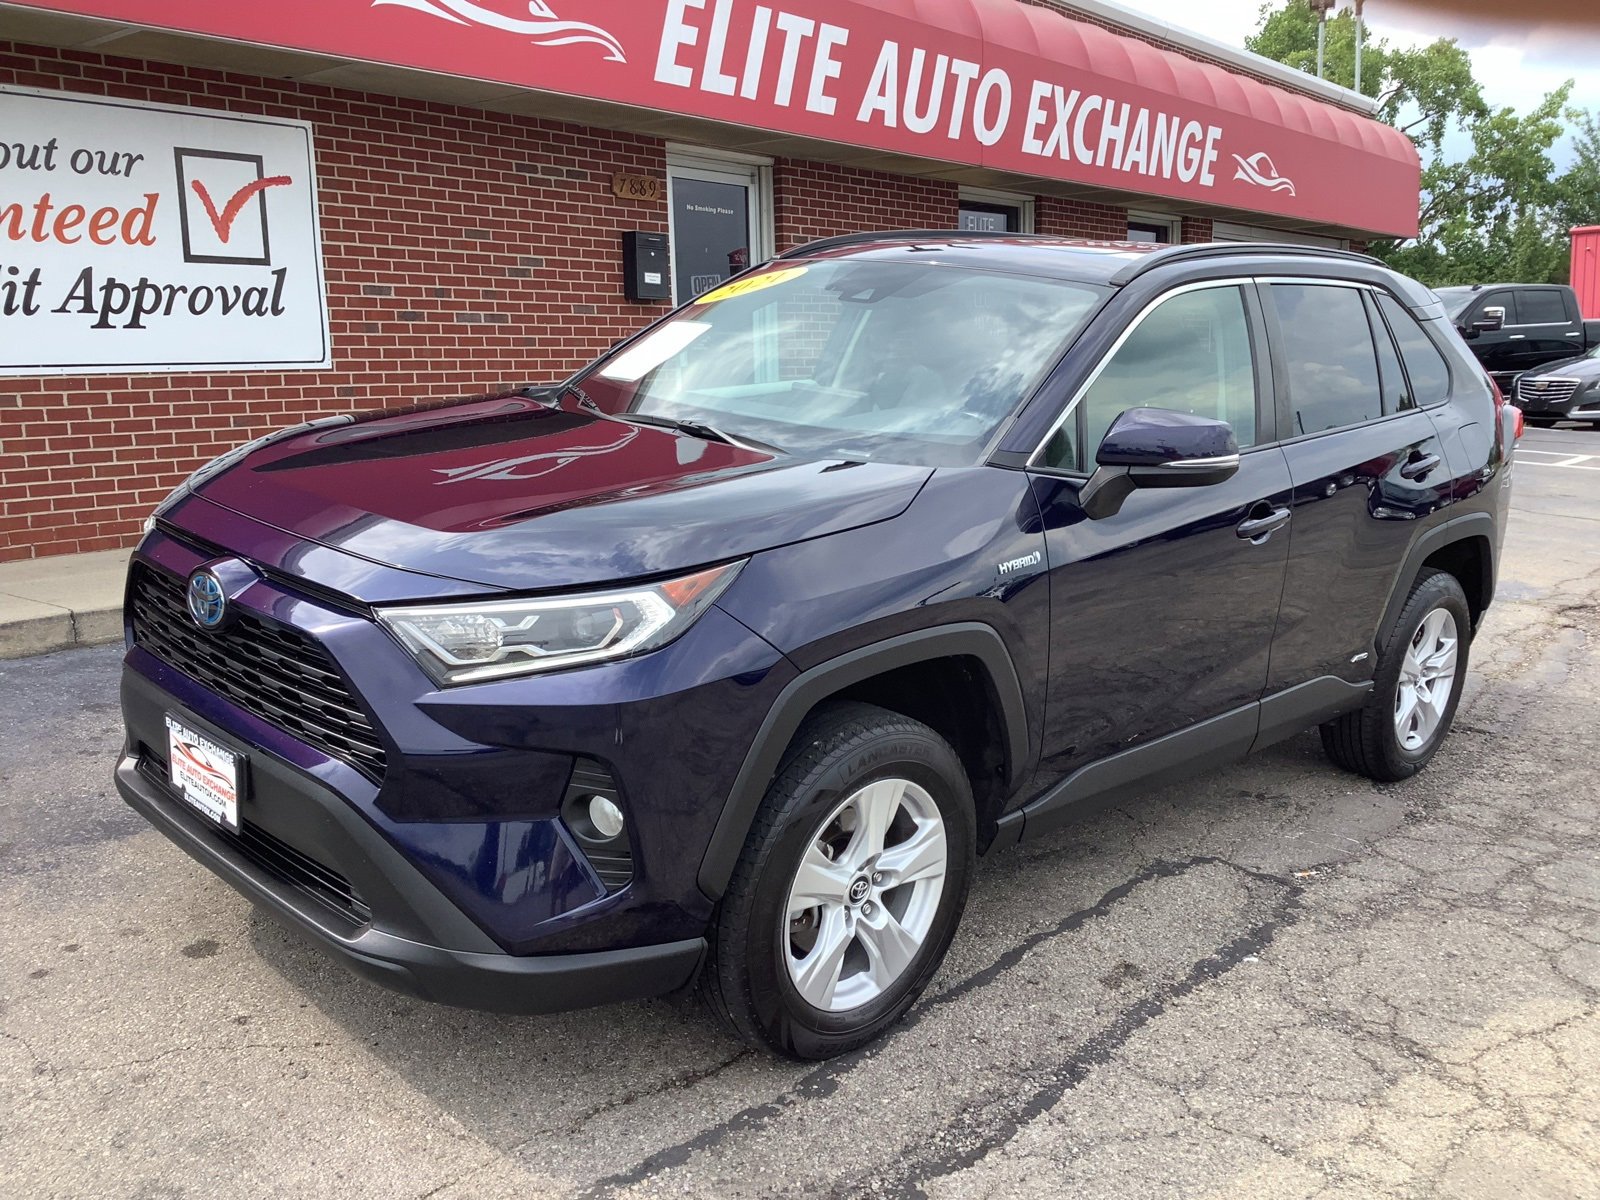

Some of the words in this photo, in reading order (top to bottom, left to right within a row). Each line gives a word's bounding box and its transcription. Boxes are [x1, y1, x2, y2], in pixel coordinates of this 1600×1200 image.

[653, 0, 849, 116] ELITE
[856, 39, 1012, 146] AUTO
[1021, 79, 1222, 187] EXCHANGE
[70, 148, 144, 177] our
[619, 178, 656, 198] 7889
[686, 203, 694, 211] No
[695, 204, 717, 215] Smoking
[717, 207, 734, 215] Please
[0, 264, 42, 316] it
[51, 266, 287, 329] Approval
[998, 554, 1034, 574] HYBRID
[182, 727, 198, 743] AUTO
[199, 737, 233, 764] EXCHANGE
[172, 753, 185, 769] ELITE
[187, 764, 201, 779] AUTO
[203, 774, 235, 803] EXCHANGE
[180, 770, 226, 808] ELITEAUTOX.COM
